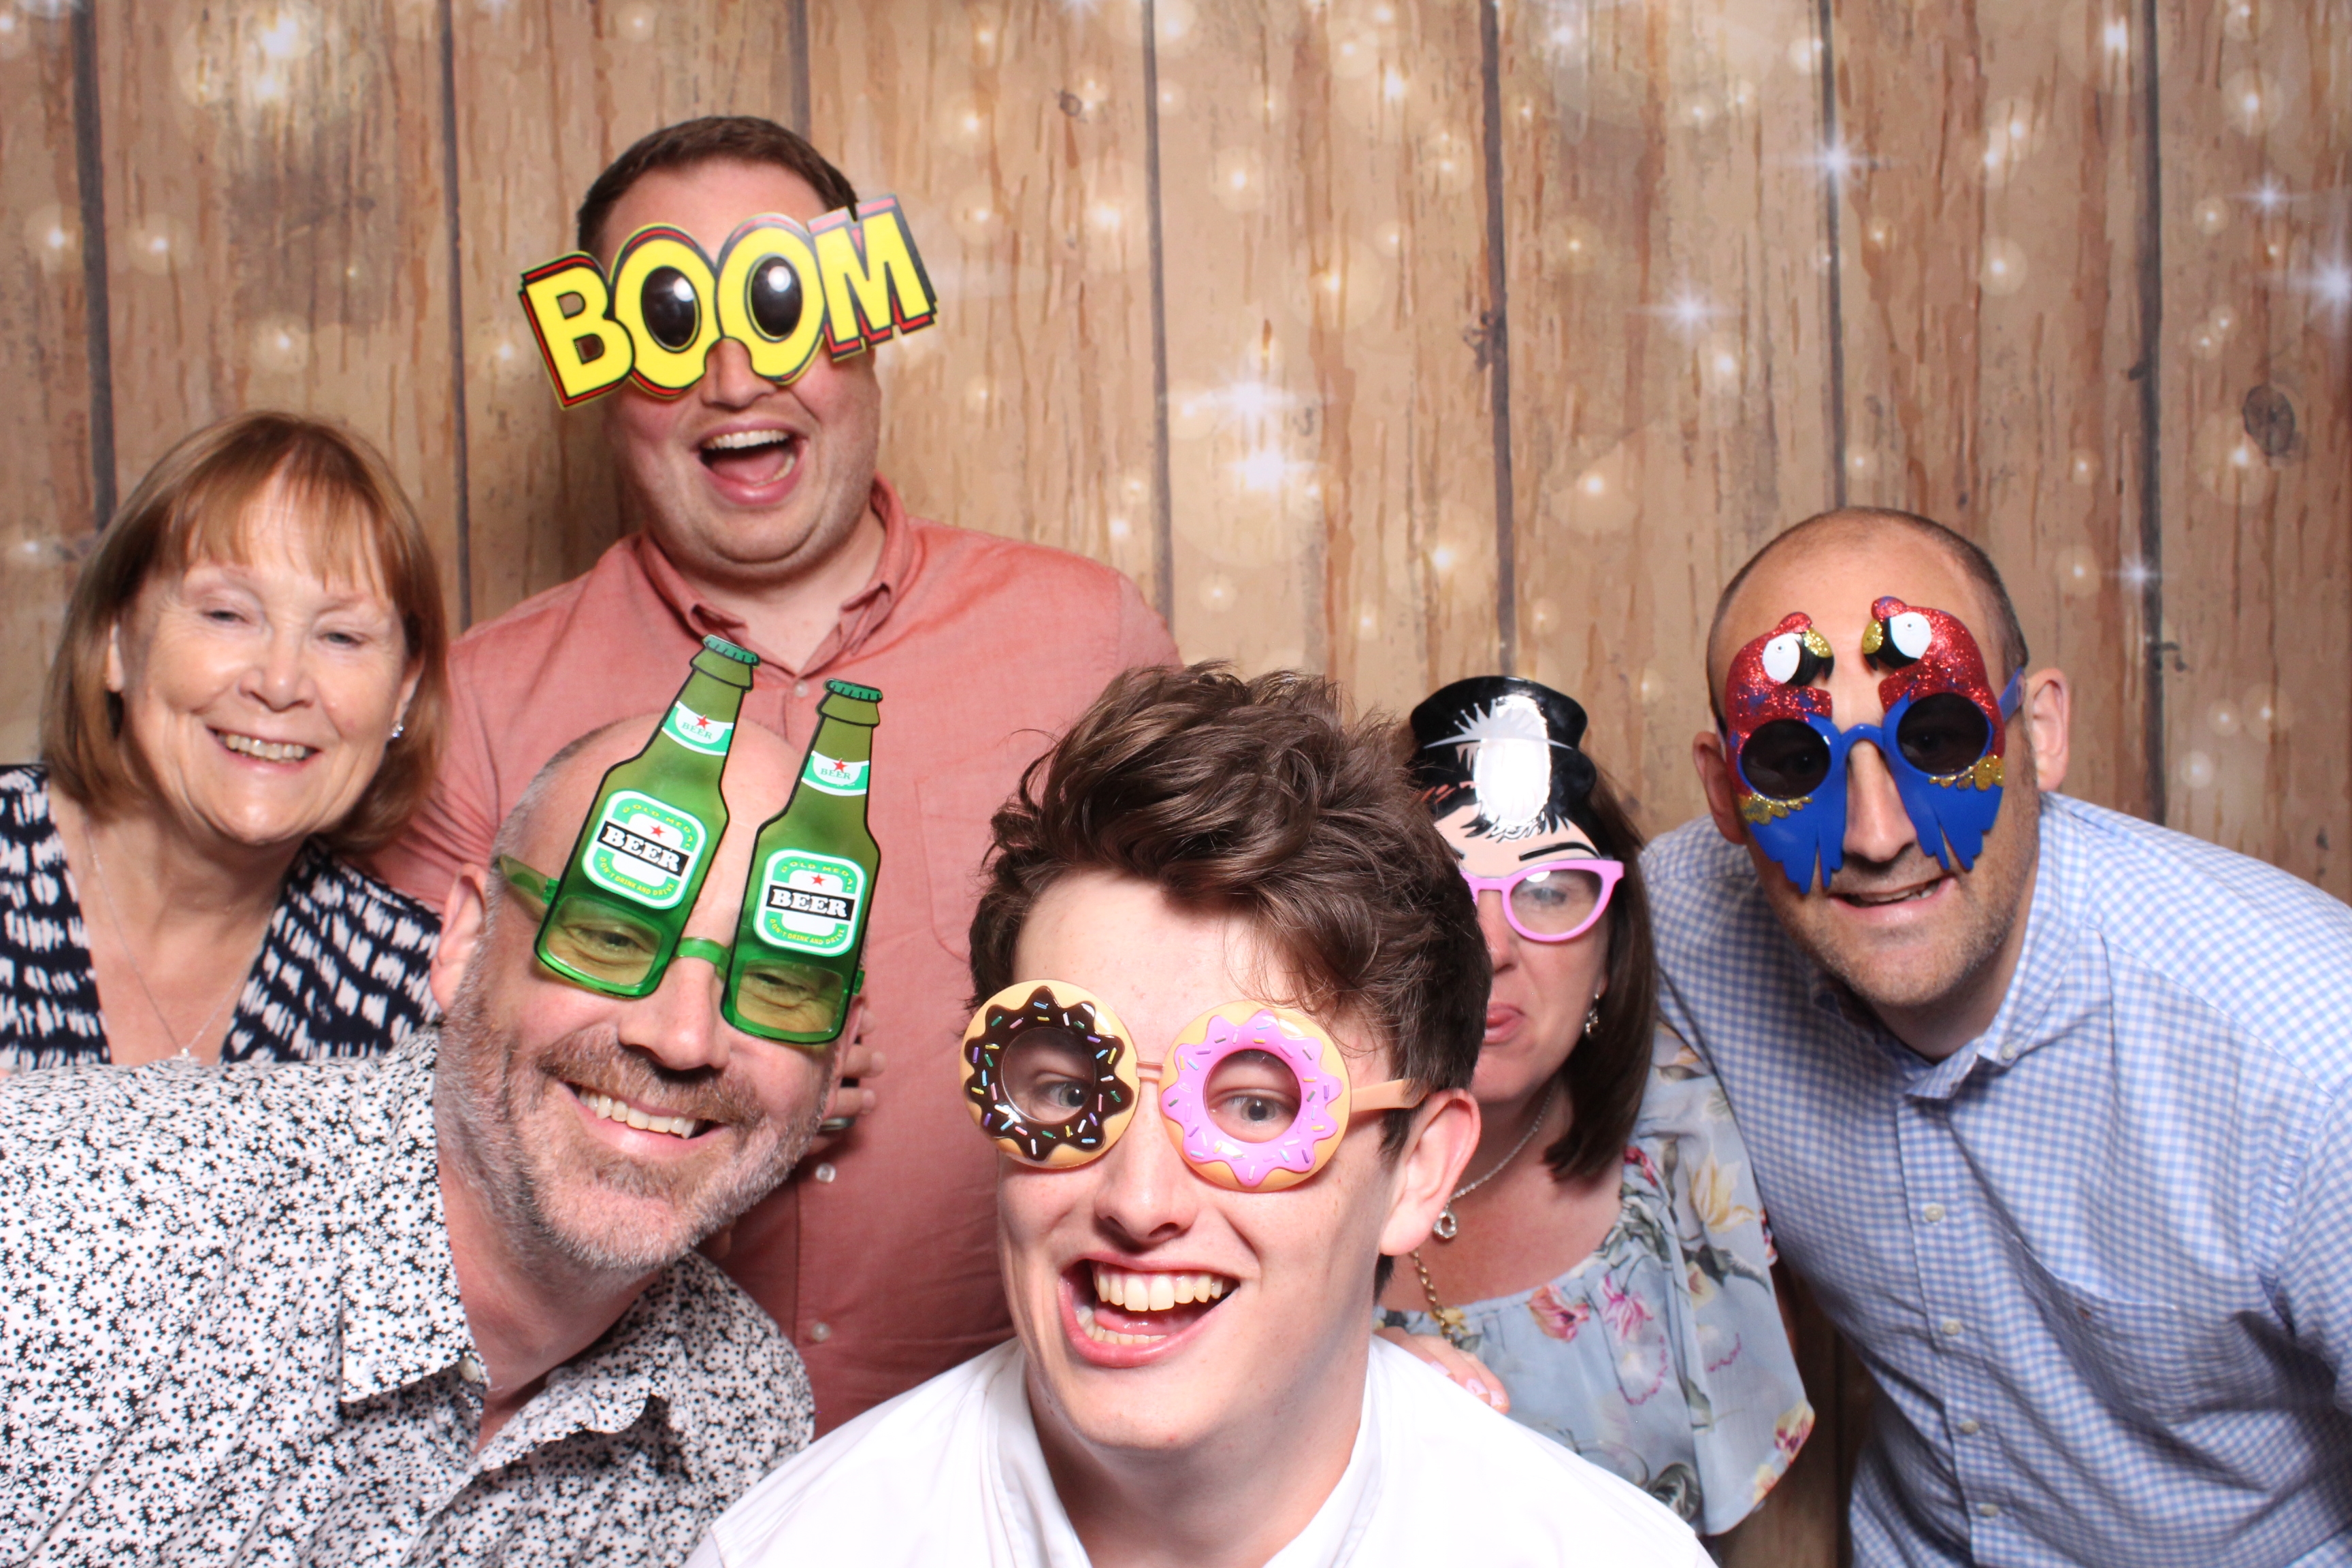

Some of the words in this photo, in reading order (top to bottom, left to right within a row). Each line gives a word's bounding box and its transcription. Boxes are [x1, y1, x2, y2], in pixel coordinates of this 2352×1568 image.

[523, 204, 934, 403] BOOM
[681, 722, 713, 740] BEER
[820, 768, 851, 780] BEER
[602, 826, 680, 872] BEER
[615, 876, 637, 889] DRINK
[637, 885, 651, 895] AND
[653, 883, 674, 896] DRIVE
[781, 861, 816, 873] GOLD
[822, 866, 853, 892] MEDAL
[770, 889, 847, 918] BEER
[787, 934, 809, 943] DRINK
[809, 937, 824, 945] AND
[826, 928, 845, 945] DRIVE
